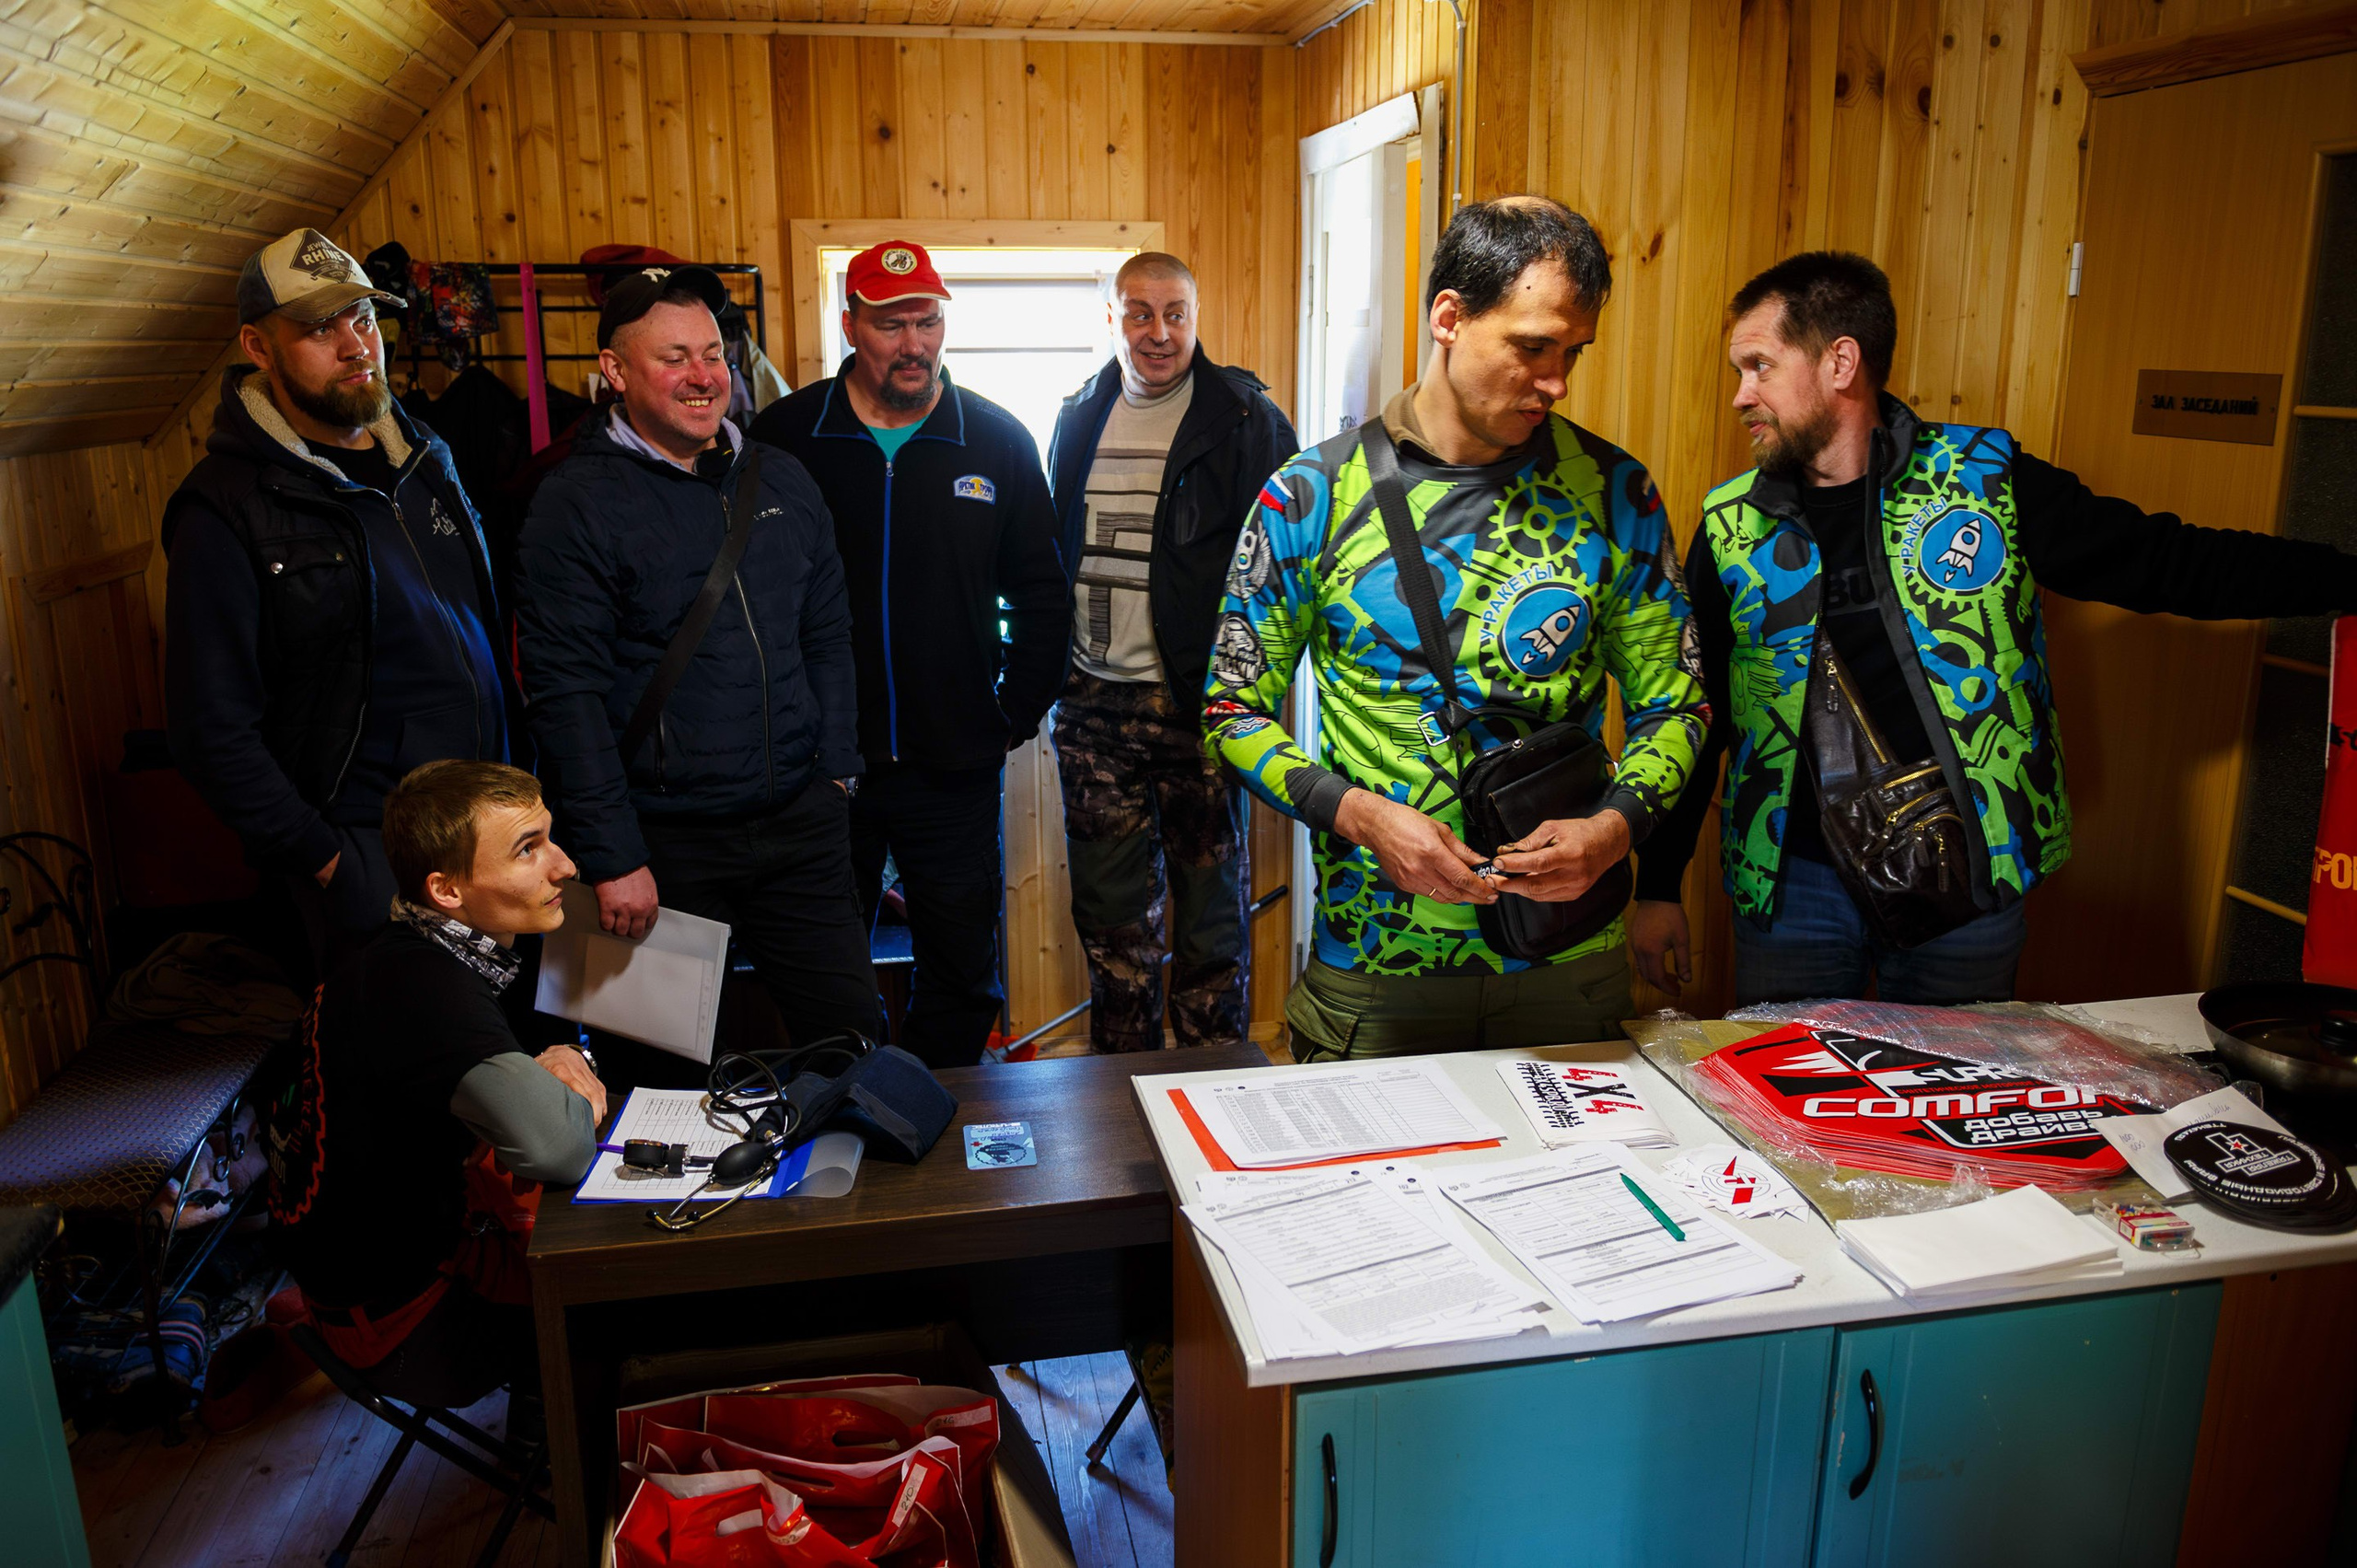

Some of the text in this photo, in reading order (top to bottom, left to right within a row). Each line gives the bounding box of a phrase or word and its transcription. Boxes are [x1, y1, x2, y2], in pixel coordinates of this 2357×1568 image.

[302, 249, 345, 266] RHINE
[2151, 394, 2259, 415] ЗАЛ ЗАСЕДАНИЙ
[1900, 495, 1948, 576] У РАКЕТЫ
[1480, 563, 1554, 642] У РАКЕТЫ
[1919, 1065, 2023, 1084] SUPR
[1896, 1084, 1980, 1095] СИНТЕТИЧЕСКОЕ
[1981, 1079, 2036, 1090] МОТОРНОЕ
[2223, 1153, 2269, 1168] ТЕХНИКА
[2247, 1154, 2294, 1173] ТЯЖЕЛАЯ
[2184, 1159, 2219, 1182] ФАРЫ
[2221, 1178, 2323, 1195] СВЕТОДИОДНЫЕ
